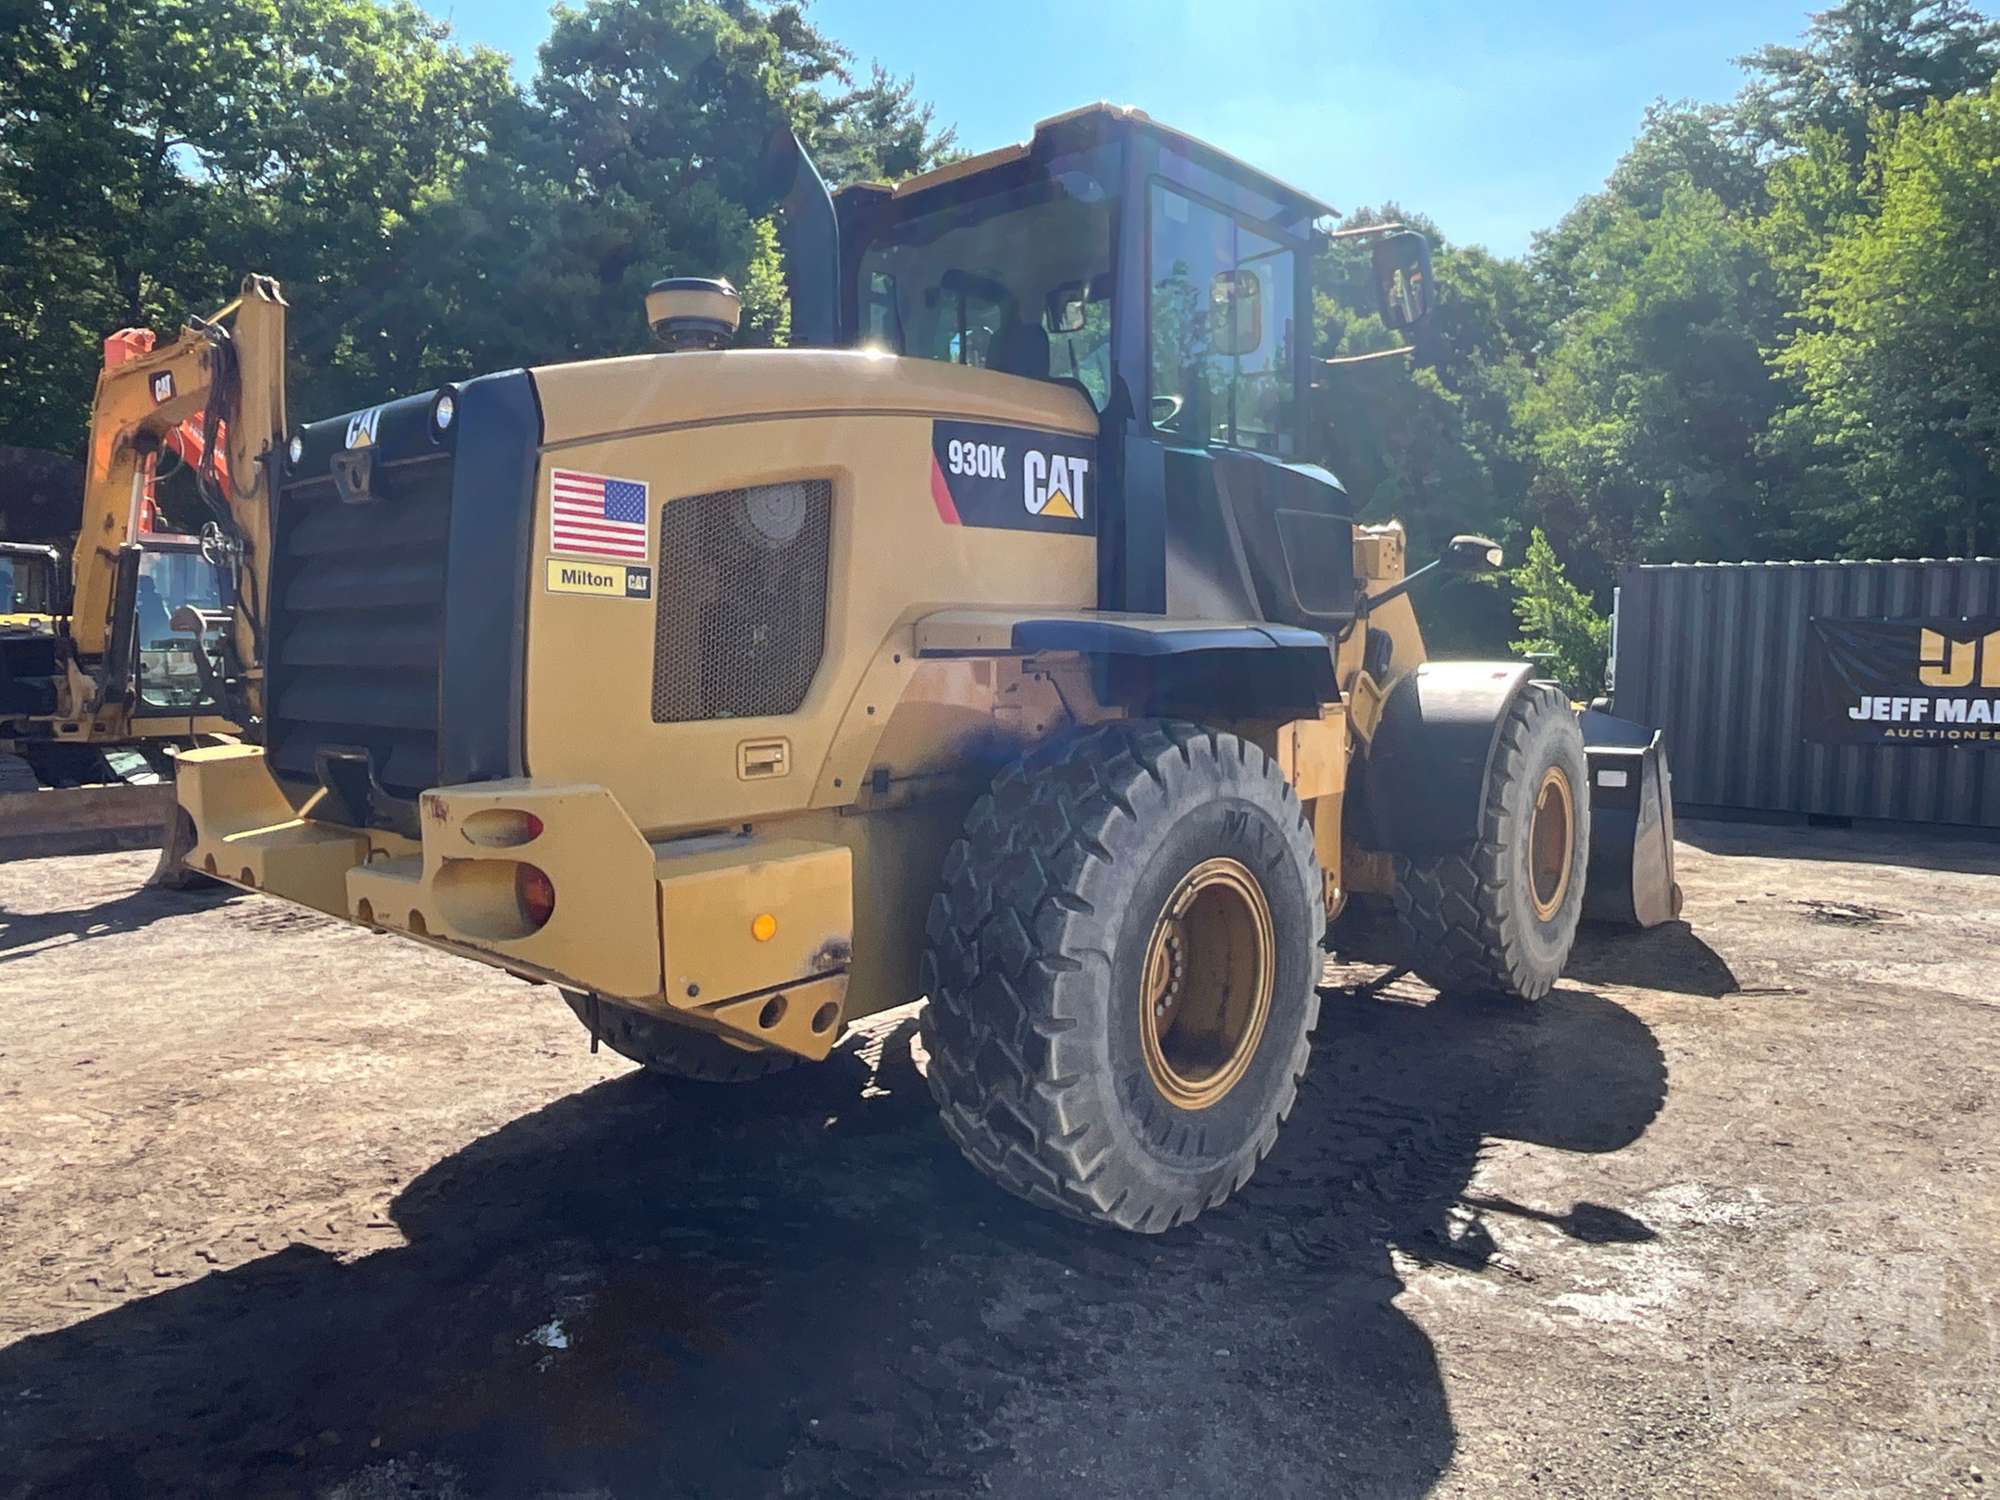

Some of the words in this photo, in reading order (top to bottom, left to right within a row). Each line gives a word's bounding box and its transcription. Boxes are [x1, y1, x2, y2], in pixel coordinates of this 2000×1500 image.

[155, 374, 171, 402] CAT
[345, 405, 384, 449] CAT
[949, 439, 1007, 479] 930K
[1024, 450, 1088, 520] CAT
[561, 569, 613, 587] Milton
[628, 575, 648, 591] CAT
[1848, 696, 1929, 722] JEFF
